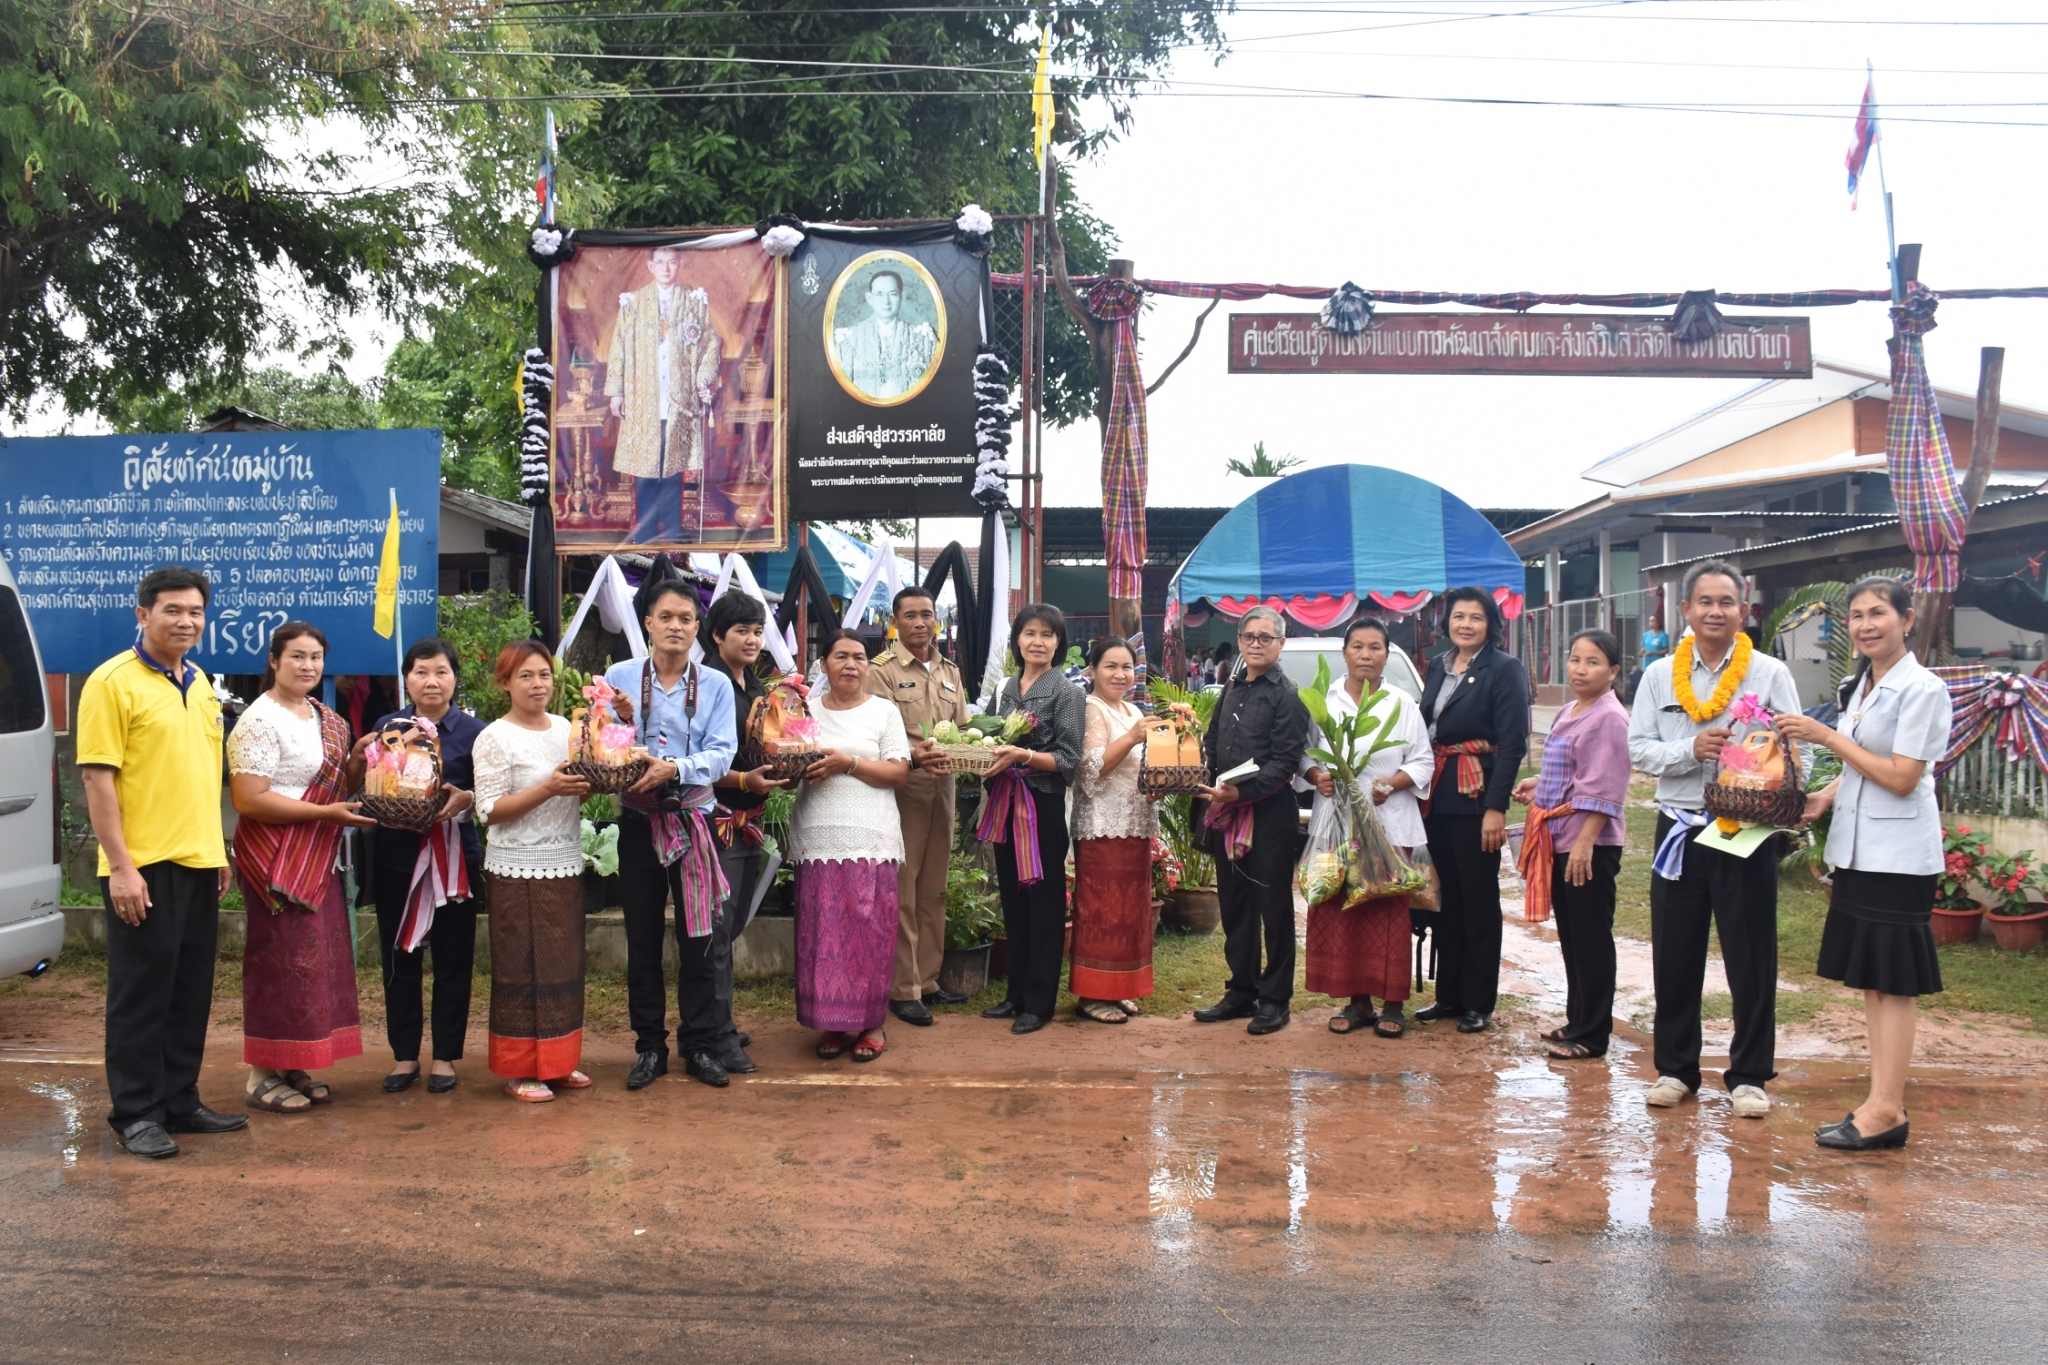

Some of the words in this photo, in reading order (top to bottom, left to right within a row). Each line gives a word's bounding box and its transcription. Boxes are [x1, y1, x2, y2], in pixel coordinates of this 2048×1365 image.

[826, 423, 946, 449] ส่งเสด็จสู่สวรรคาลัย
[124, 441, 314, 495] วิสัยทัศน์หมู่บ้าน
[230, 567, 241, 584] 5
